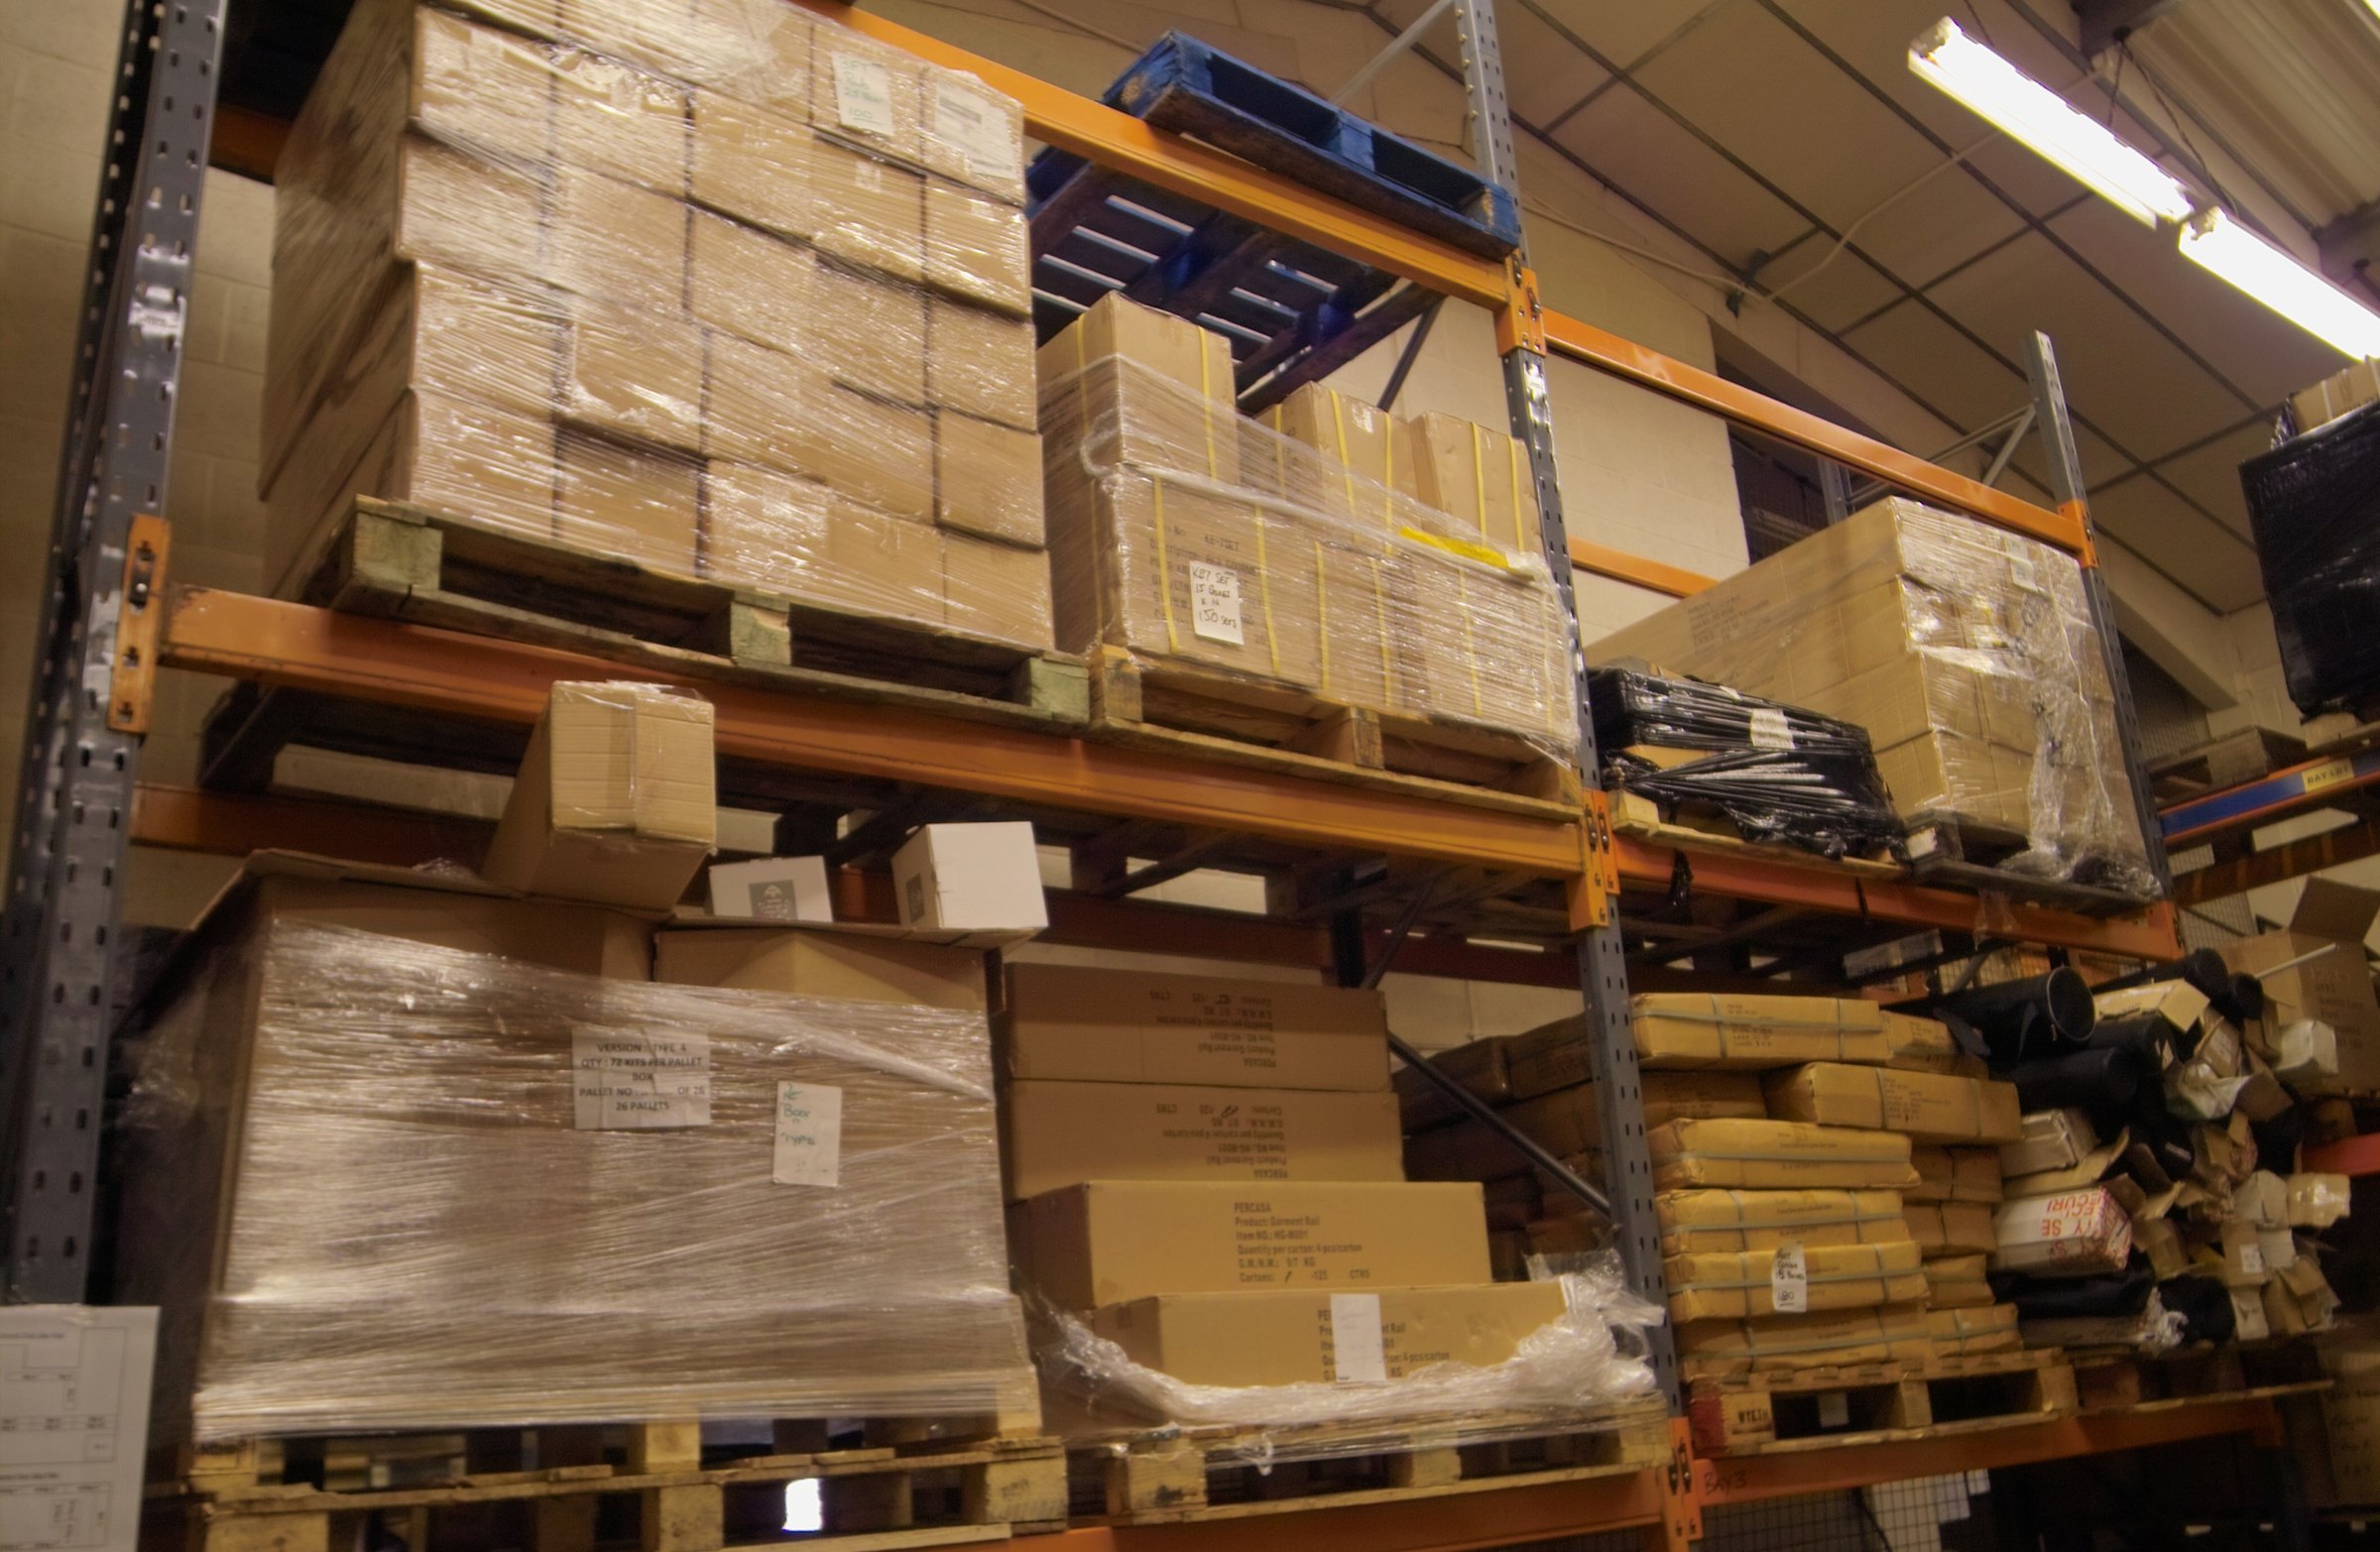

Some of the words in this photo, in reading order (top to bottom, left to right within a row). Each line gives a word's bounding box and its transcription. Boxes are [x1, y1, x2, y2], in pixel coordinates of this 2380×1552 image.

[1199, 608, 1219, 622] 150
[597, 1042, 642, 1053] VERSION
[581, 1058, 602, 1069] QTY
[668, 1056, 702, 1067] PALLET
[632, 1072, 654, 1081] BOX
[579, 1087, 613, 1097] PALLET
[616, 1102, 628, 1111] 26
[630, 1101, 669, 1111] PALLETS
[1234, 1202, 1271, 1213] PERCASA
[1270, 1216, 1303, 1227] Garment
[1305, 1214, 1320, 1226] Rail
[1236, 1230, 1254, 1241] Item
[1238, 1245, 1271, 1256] Quantity
[1272, 1246, 1285, 1256] per
[1390, 1322, 1406, 1333] Rail
